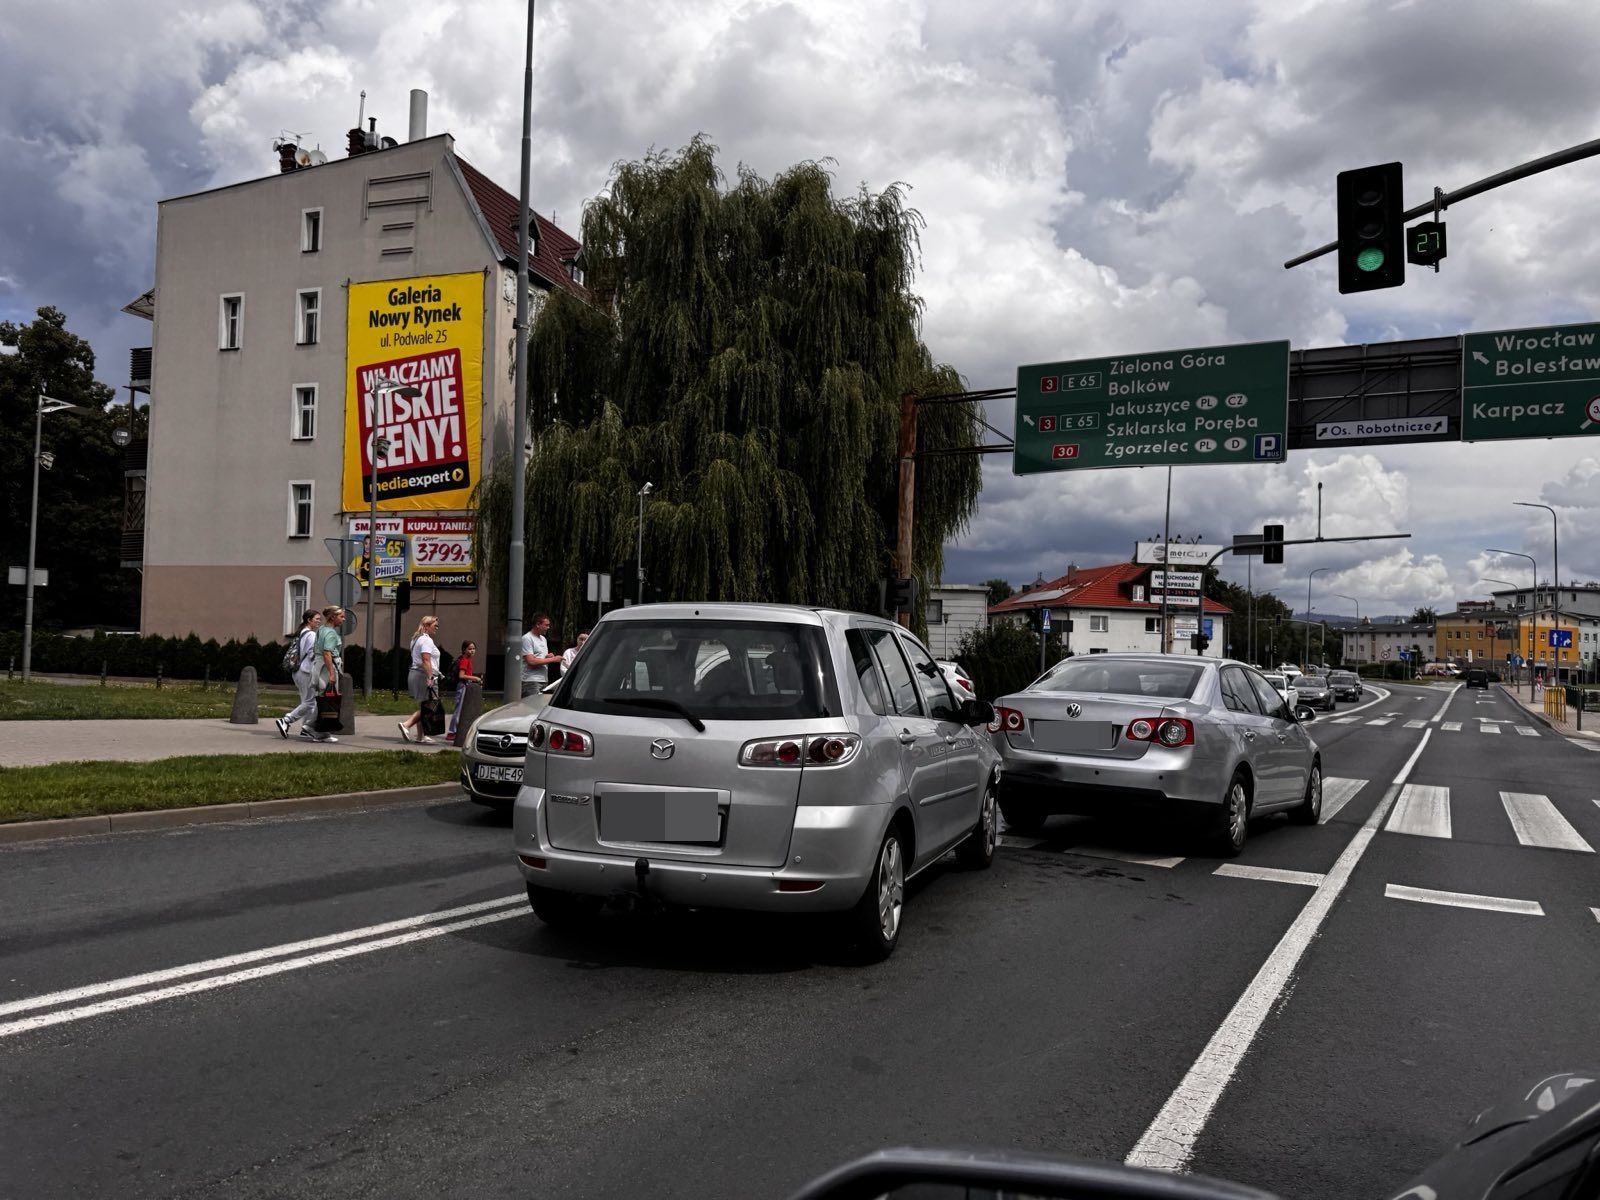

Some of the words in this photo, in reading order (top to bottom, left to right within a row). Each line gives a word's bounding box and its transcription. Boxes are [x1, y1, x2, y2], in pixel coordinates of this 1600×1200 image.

[1417, 231, 1440, 253] 27
[388, 284, 442, 306] Galeria
[369, 309, 410, 330] Nowy
[413, 303, 462, 328] Rynek
[380, 333, 392, 347] ul.
[394, 330, 433, 346] Podwale
[435, 329, 448, 343] 25
[1494, 331, 1596, 352] Wrocław
[1109, 358, 1174, 376] Zielona
[1180, 352, 1226, 370] Góra
[1045, 379, 1054, 390] 3
[1067, 377, 1075, 388] E
[1079, 375, 1096, 387] 65
[1108, 379, 1171, 396] Bolków
[1106, 399, 1191, 418] Jakuszyce
[1200, 398, 1213, 407] PL
[1227, 396, 1243, 406] CZ
[1472, 400, 1566, 422] Karpacz
[1043, 418, 1052, 429] 3
[1065, 417, 1073, 428] E
[1077, 415, 1094, 427] 65
[1106, 420, 1186, 438] Szklarska
[1194, 415, 1259, 433] Poręba
[1330, 425, 1351, 437] Os.
[1357, 421, 1432, 435] Robotnicze
[1058, 446, 1074, 457] 30
[1104, 440, 1189, 459] Zgorzelec
[1199, 440, 1213, 450] PL
[1231, 439, 1241, 448] D
[1266, 450, 1280, 458] BUS
[354, 522, 387, 532] SMRT
[388, 522, 400, 532] TV
[407, 522, 438, 531] KUPUJ
[375, 565, 403, 576] PHILIPS
[416, 574, 465, 583] mediaexpert
[1154, 574, 1199, 582] NIEUCHOMOŚĆ
[480, 764, 497, 780] DJE
